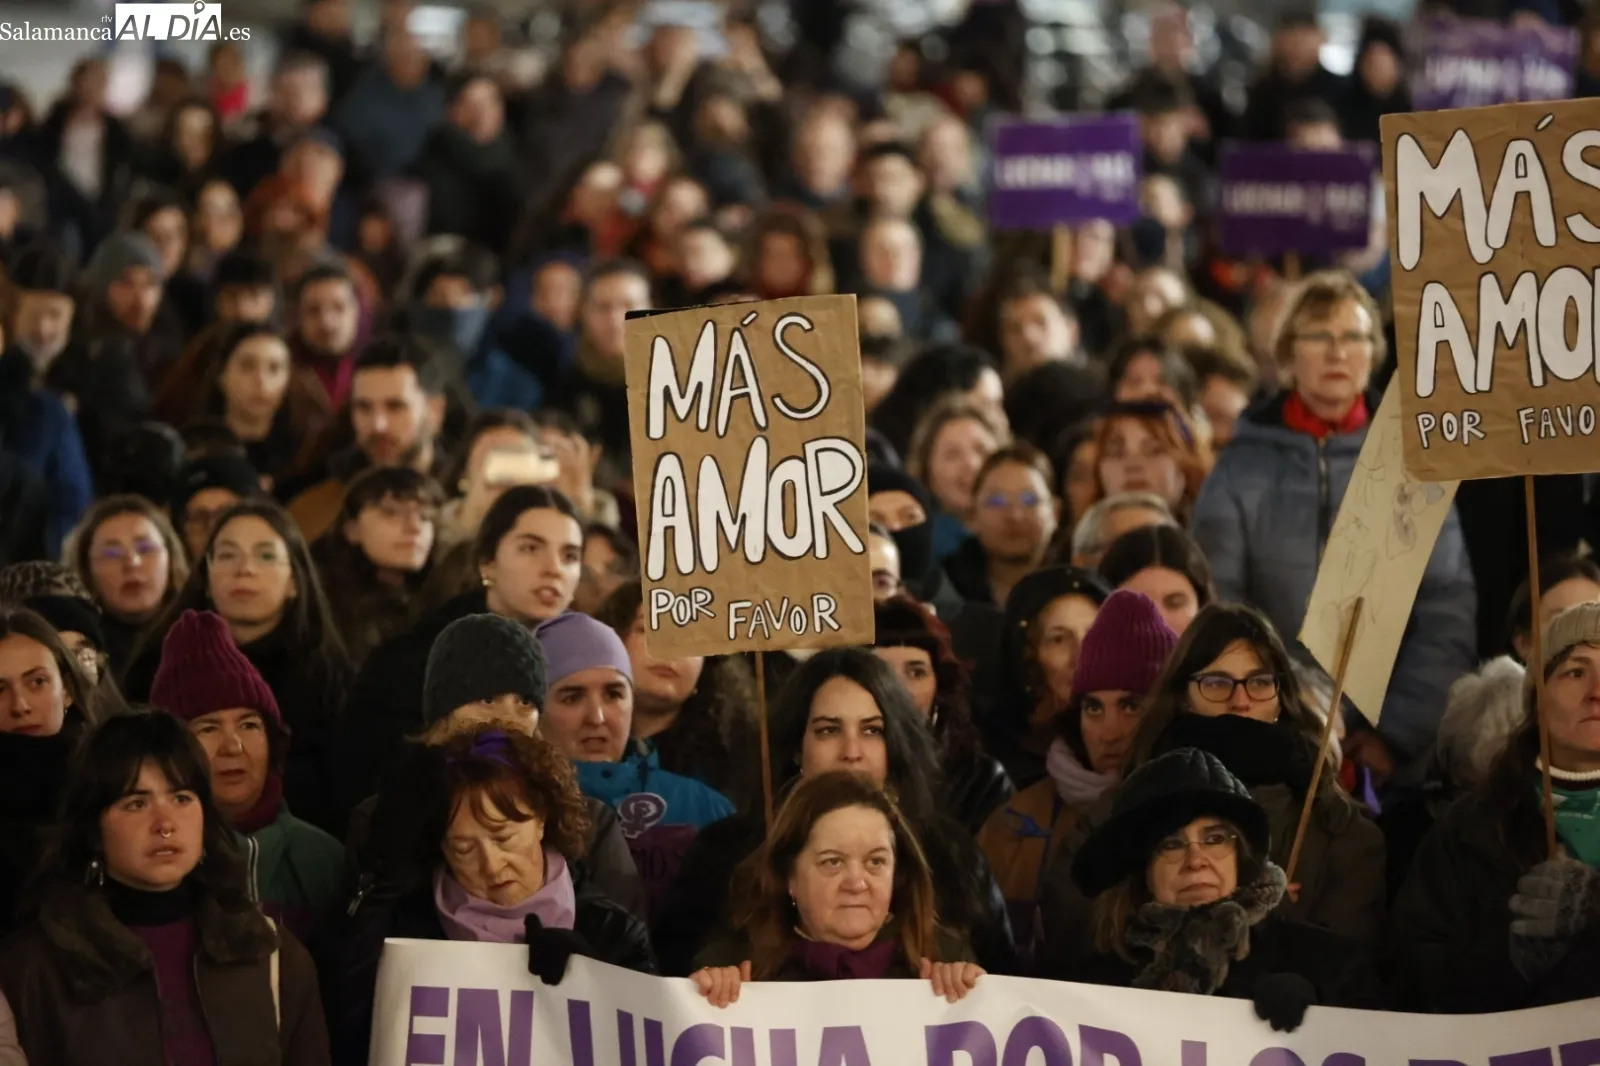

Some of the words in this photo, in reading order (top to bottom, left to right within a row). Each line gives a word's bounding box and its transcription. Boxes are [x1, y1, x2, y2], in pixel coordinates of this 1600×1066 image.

[646, 310, 832, 441] MÁS
[1415, 265, 1600, 398] AMO
[1416, 409, 1487, 449] POR
[646, 434, 867, 582] AMOR
[650, 587, 716, 631] POR
[728, 593, 841, 641] FAVOR
